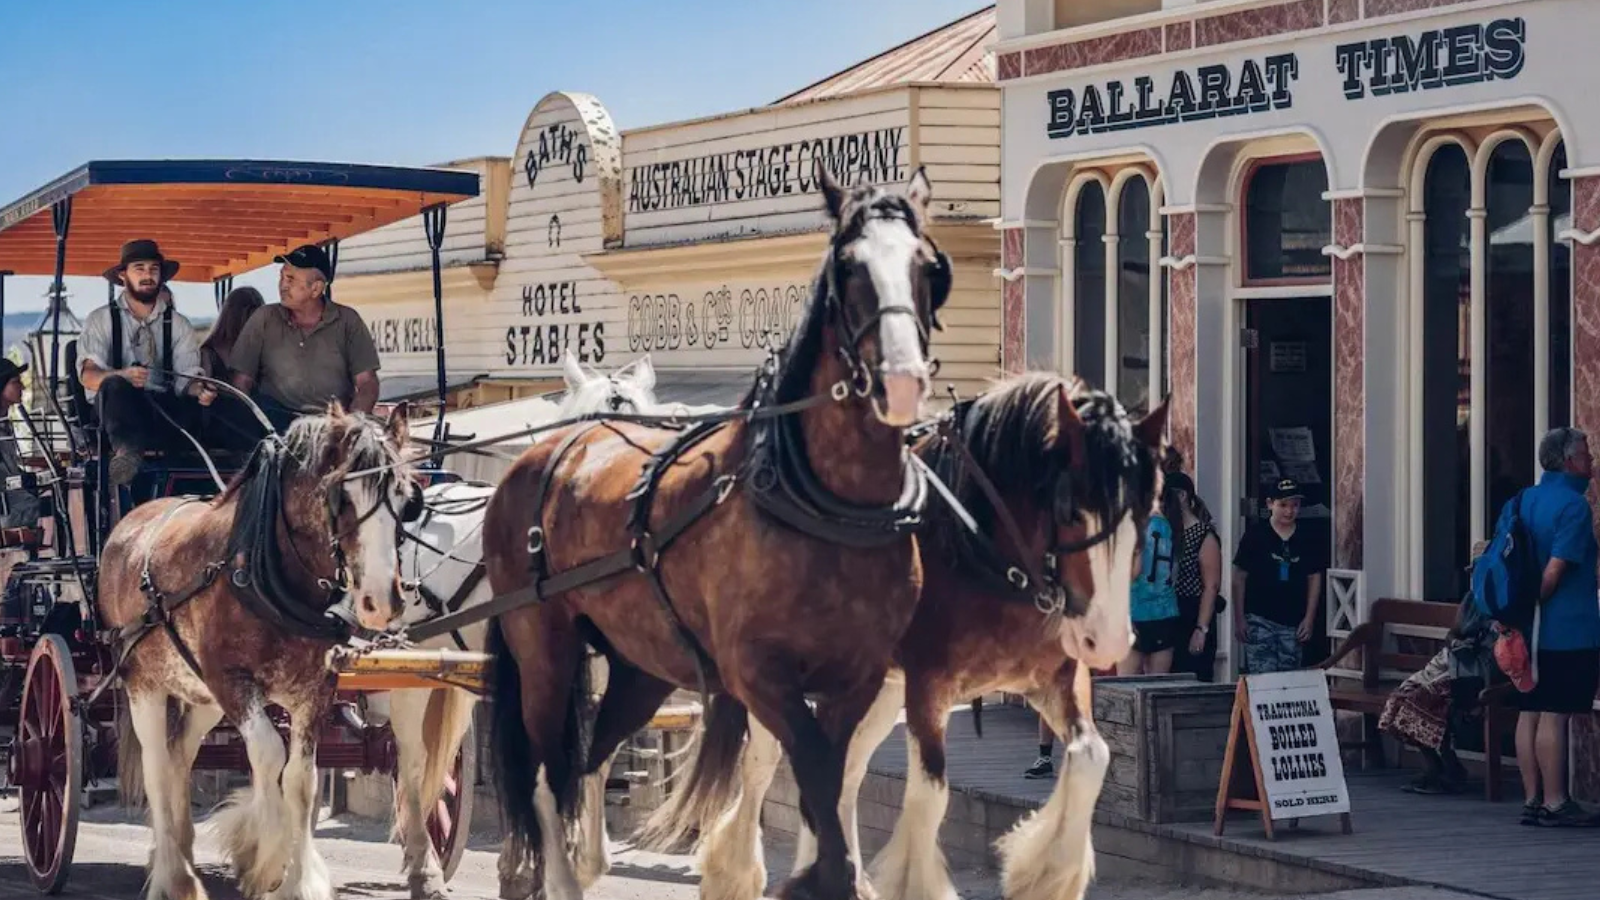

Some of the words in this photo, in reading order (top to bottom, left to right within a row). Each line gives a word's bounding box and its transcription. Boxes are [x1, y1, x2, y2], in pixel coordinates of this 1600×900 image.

[1047, 53, 1299, 138] BALLARAT
[1336, 17, 1526, 100] TIMES
[525, 124, 587, 190] BATH'S
[629, 153, 730, 211] AUSTRALIAN
[735, 144, 792, 199] STAGE
[522, 282, 582, 317] HOTEL
[628, 294, 682, 352] COBB
[685, 303, 699, 346] &
[739, 285, 806, 350] COAC
[1256, 700, 1321, 721] TRADITIONAL
[1269, 723, 1318, 750] BOILED
[1271, 753, 1327, 781] LOLLIES
[1274, 797, 1305, 808] SOLD
[1306, 794, 1339, 806] HERE
